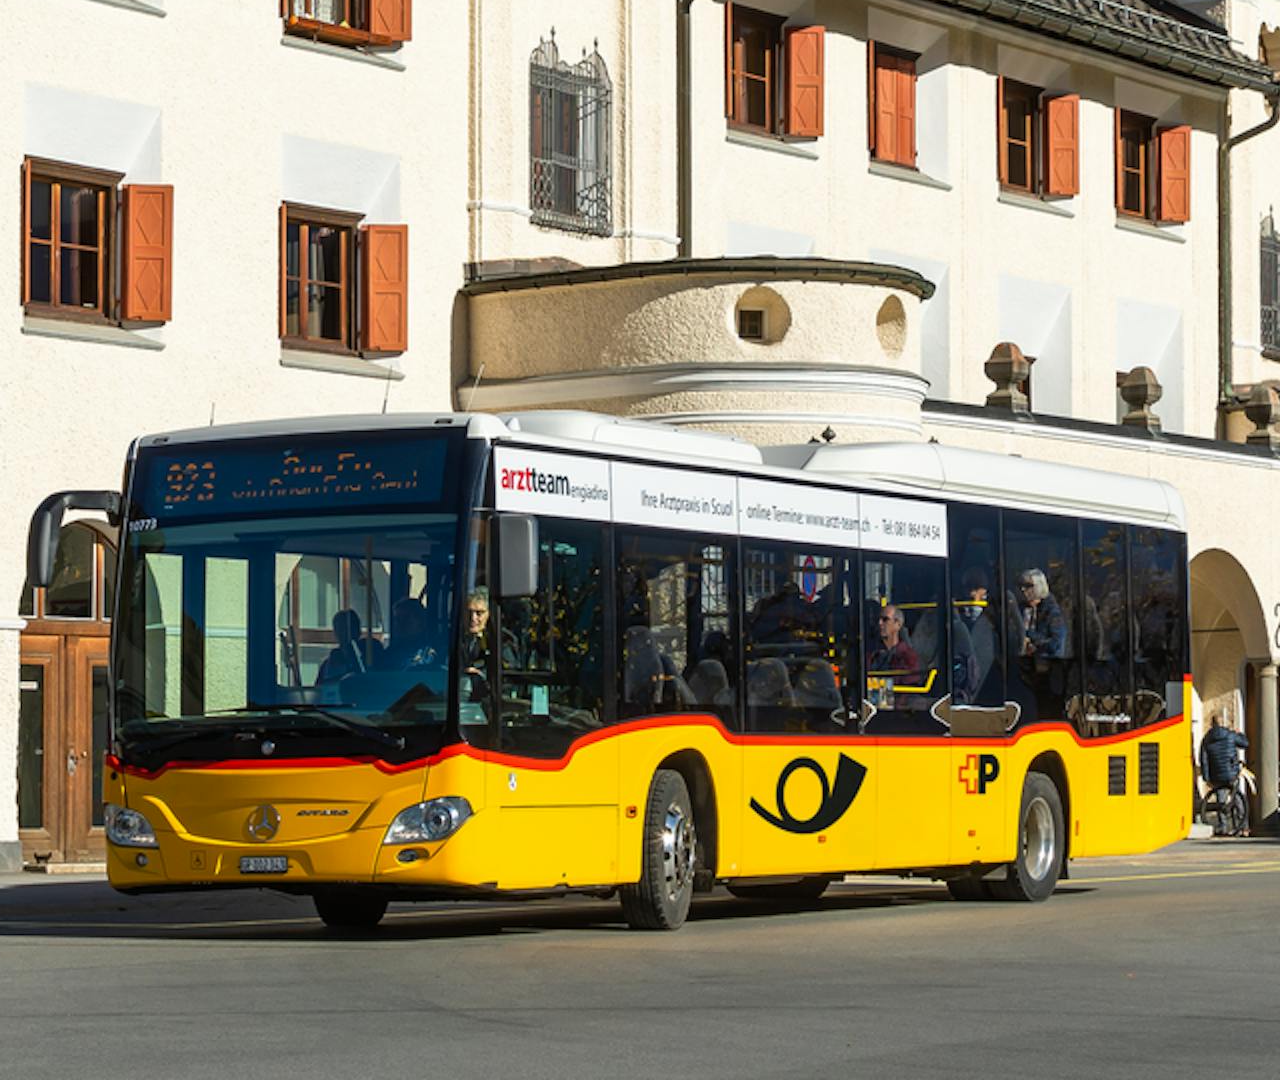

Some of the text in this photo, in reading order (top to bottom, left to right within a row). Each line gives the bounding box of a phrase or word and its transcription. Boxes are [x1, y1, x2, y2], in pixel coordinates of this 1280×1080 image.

[640, 489, 658, 508] Ihre
[659, 493, 701, 515] Arztpraxis
[701, 497, 710, 512] in
[711, 498, 733, 516] Scuol
[746, 503, 771, 521] online
[978, 754, 1000, 794] P
